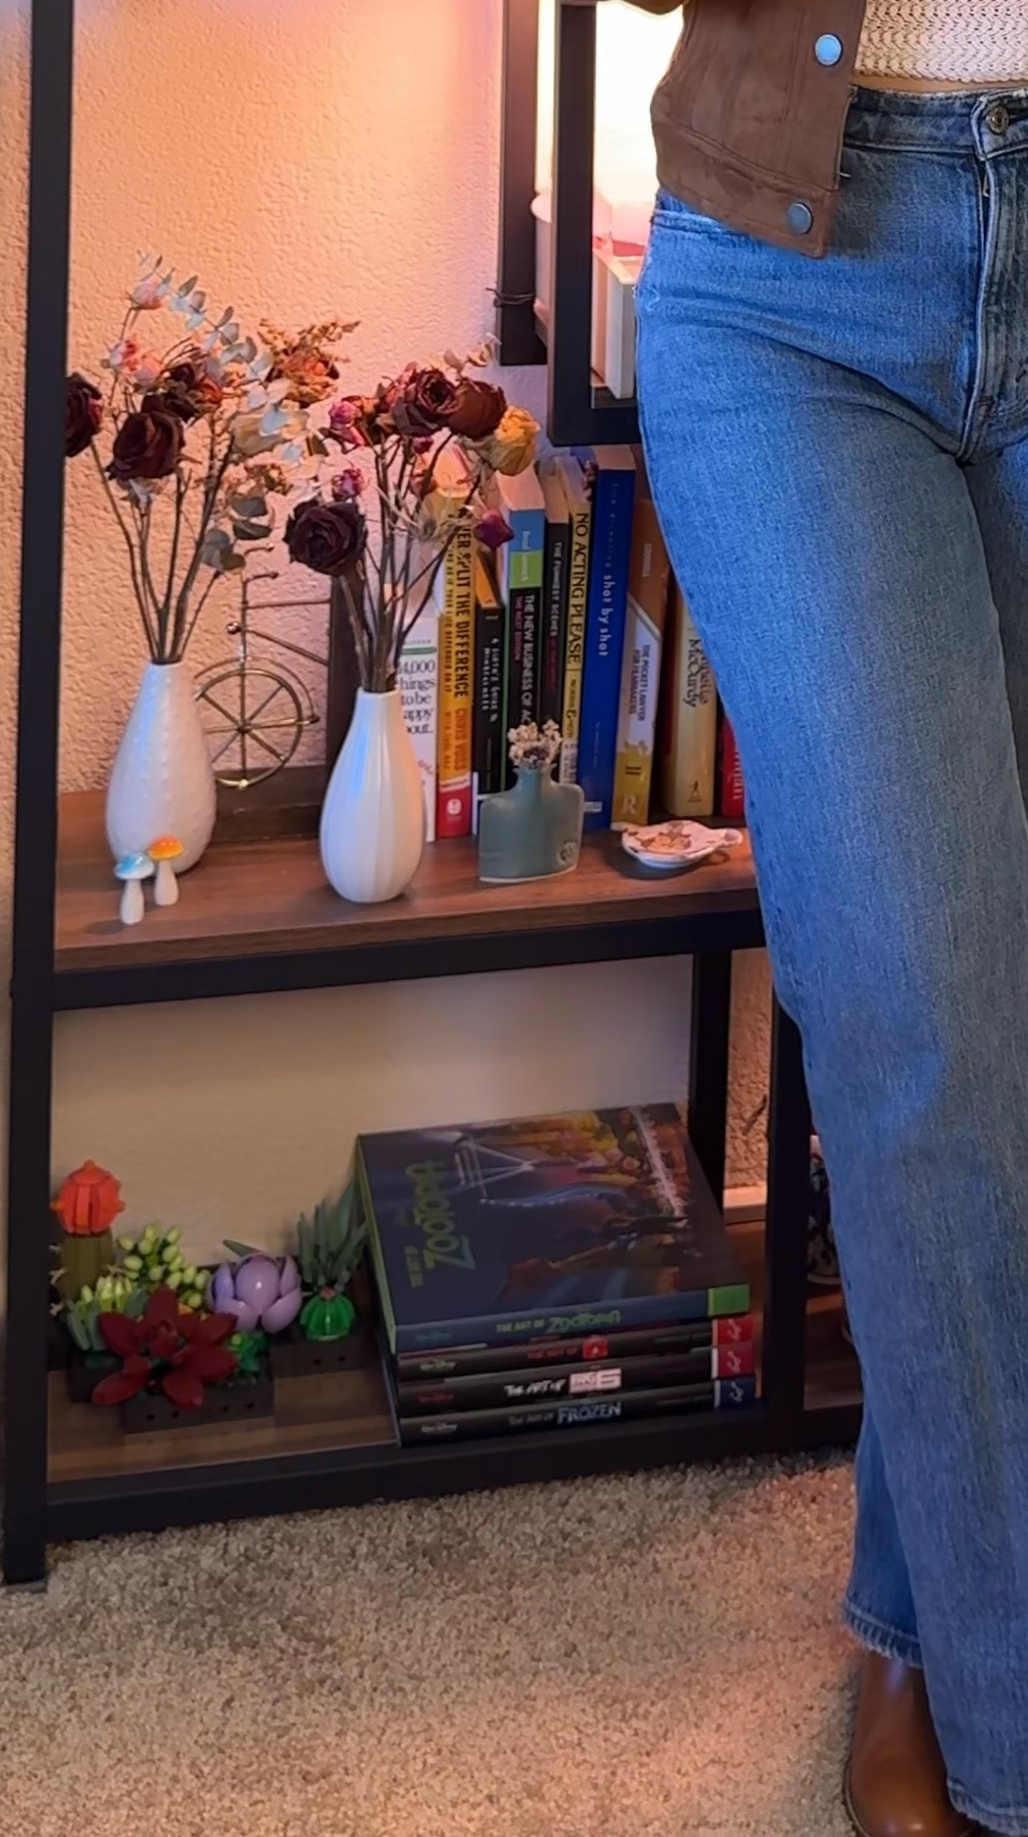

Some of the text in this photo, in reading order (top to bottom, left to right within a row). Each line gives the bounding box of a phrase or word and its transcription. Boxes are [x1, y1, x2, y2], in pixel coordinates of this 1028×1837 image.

[456, 552, 472, 587] SPLIT
[568, 513, 589, 664] NO ACTING PLEASE
[602, 575, 616, 603] shot
[456, 592, 471, 617] THE
[523, 595, 535, 613] THE
[598, 607, 613, 624] by
[523, 615, 534, 641] NEW
[598, 627, 612, 656] shot
[454, 621, 470, 698] DIFFERENCE
[521, 643, 534, 691] BUSINESS
[683, 639, 703, 708] McCurdy
[400, 676, 437, 692] hings
[640, 660, 650, 689] POCKET
[521, 692, 532, 706] OF
[637, 690, 648, 722] LAWYER
[557, 1401, 622, 1425] FROZEN
